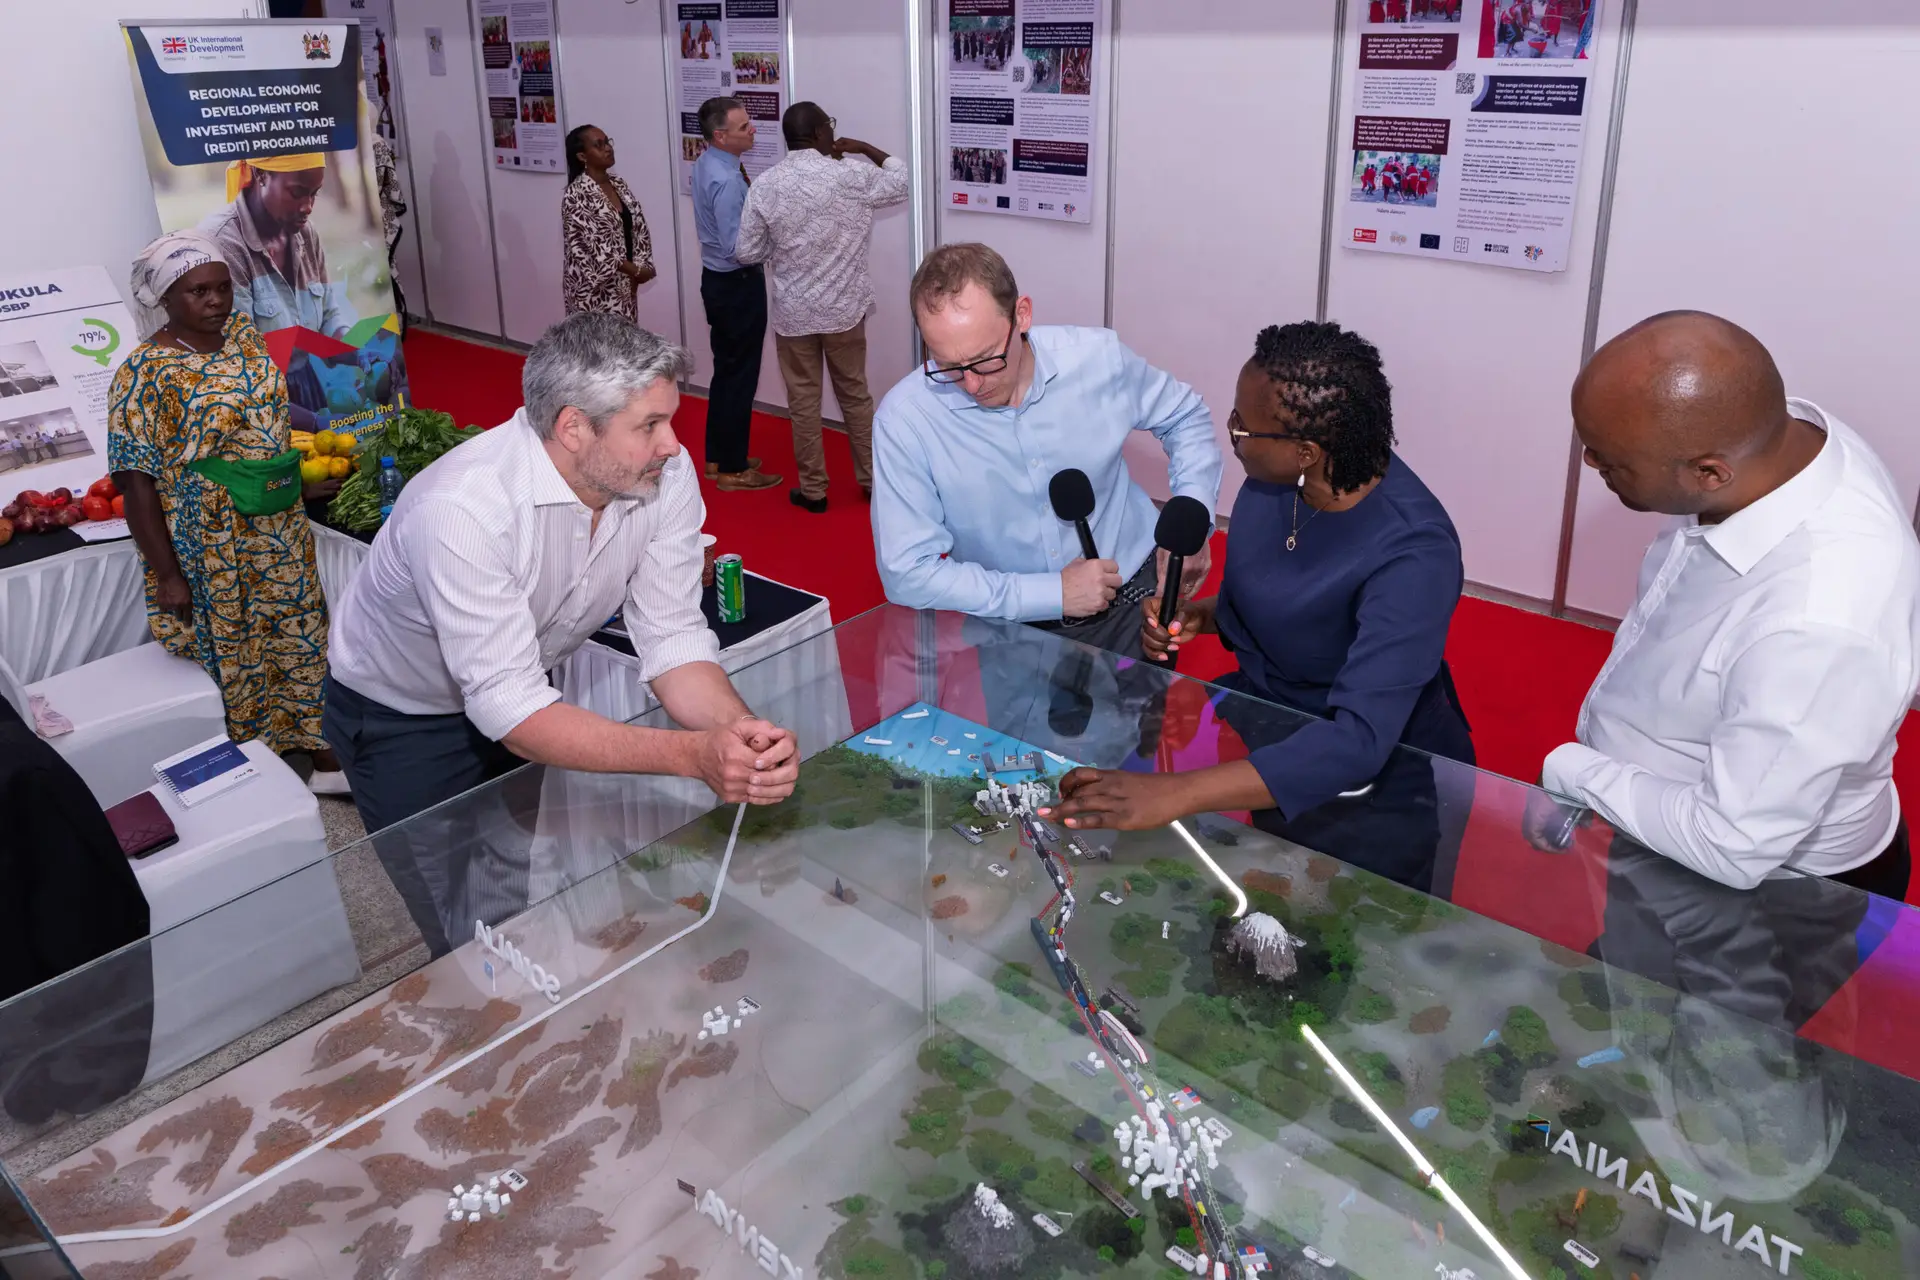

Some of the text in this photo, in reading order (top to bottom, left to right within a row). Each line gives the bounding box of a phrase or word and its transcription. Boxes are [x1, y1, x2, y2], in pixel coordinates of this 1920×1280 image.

[201, 35, 242, 43] International
[190, 44, 244, 54] Development
[188, 84, 322, 101] REGIONAL ECONOMIC
[201, 101, 319, 119] DEVELOPMENT FOR
[185, 117, 336, 138] INVESTMENT AND TRADE
[204, 134, 328, 156] (REDIT) PROGRAMME
[0, 302, 30, 313] SBP
[79, 331, 106, 344] 79%
[329, 409, 374, 429] Boosting
[376, 403, 394, 414] the
